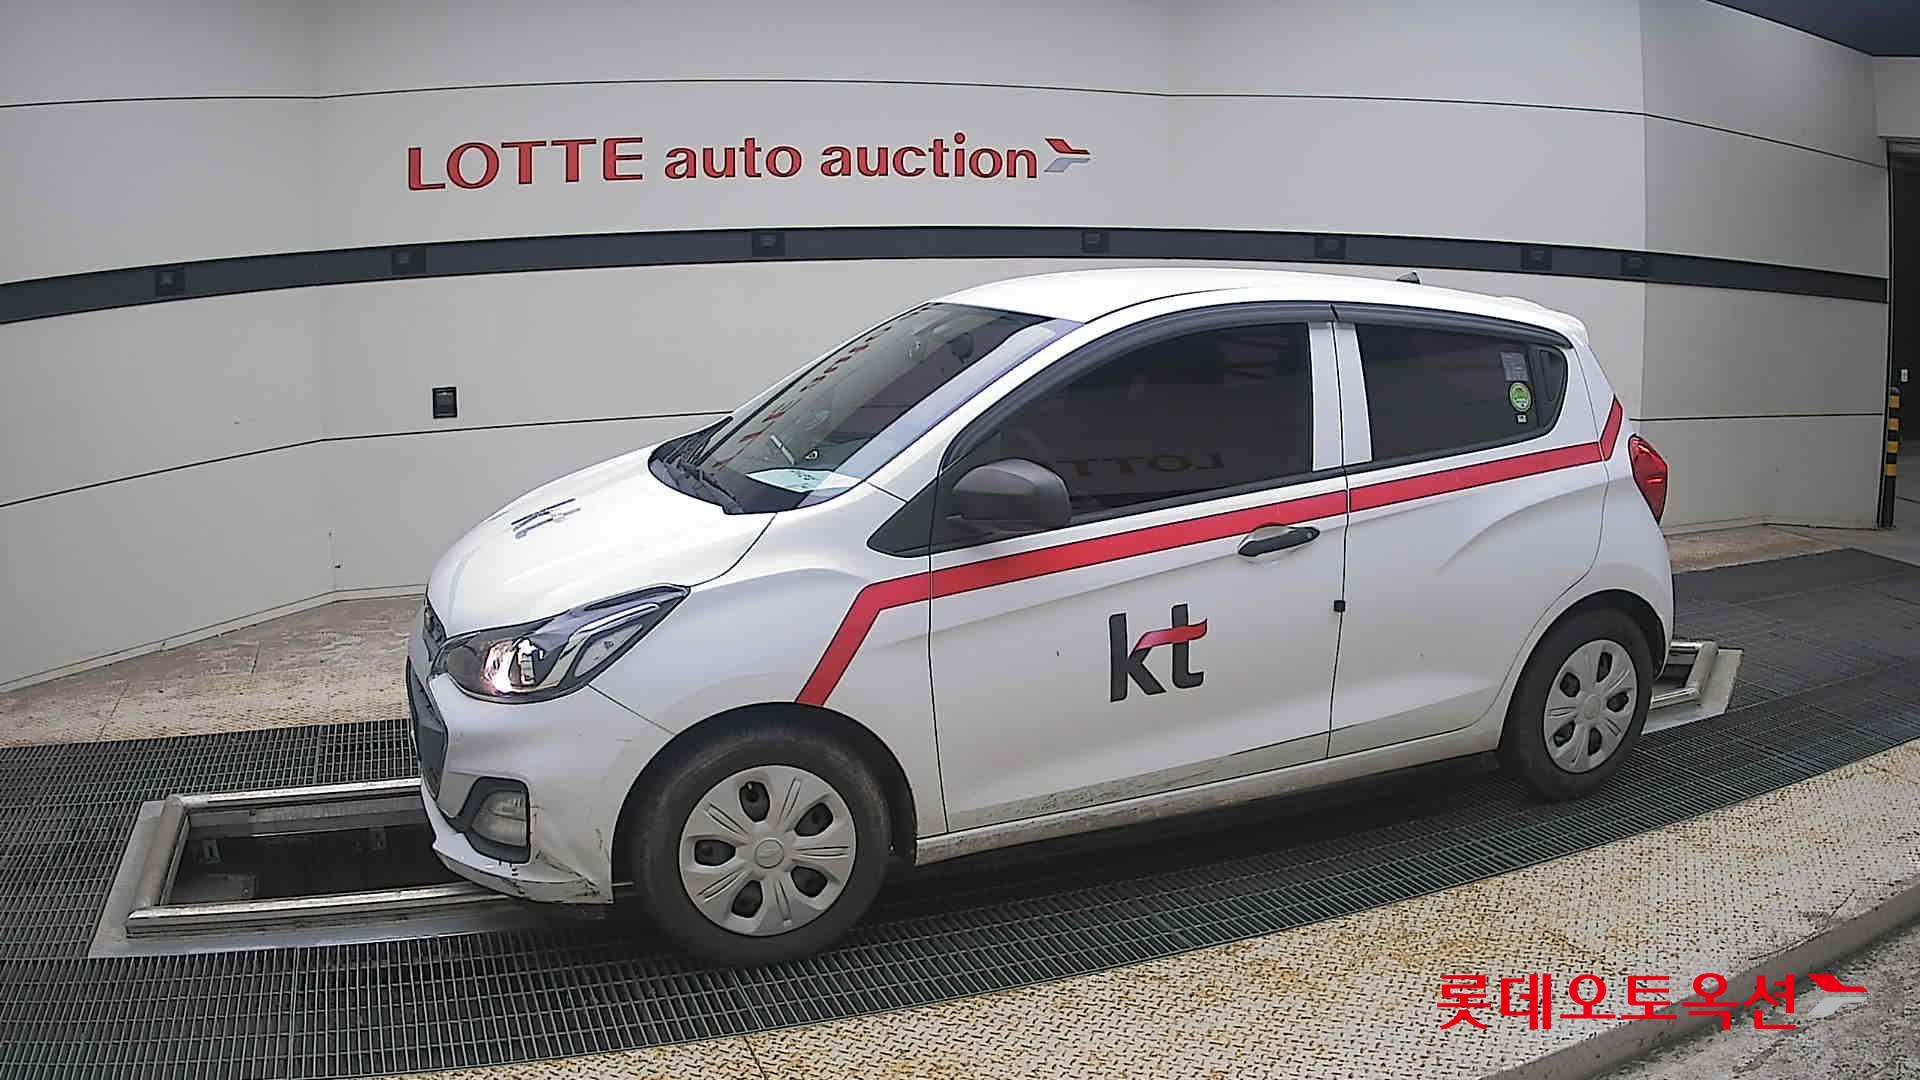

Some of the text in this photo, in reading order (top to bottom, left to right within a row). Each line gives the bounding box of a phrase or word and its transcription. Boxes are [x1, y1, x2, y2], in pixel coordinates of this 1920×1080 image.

[407, 131, 1039, 191] LOTTE auto auction
[1108, 602, 1209, 703] kt
